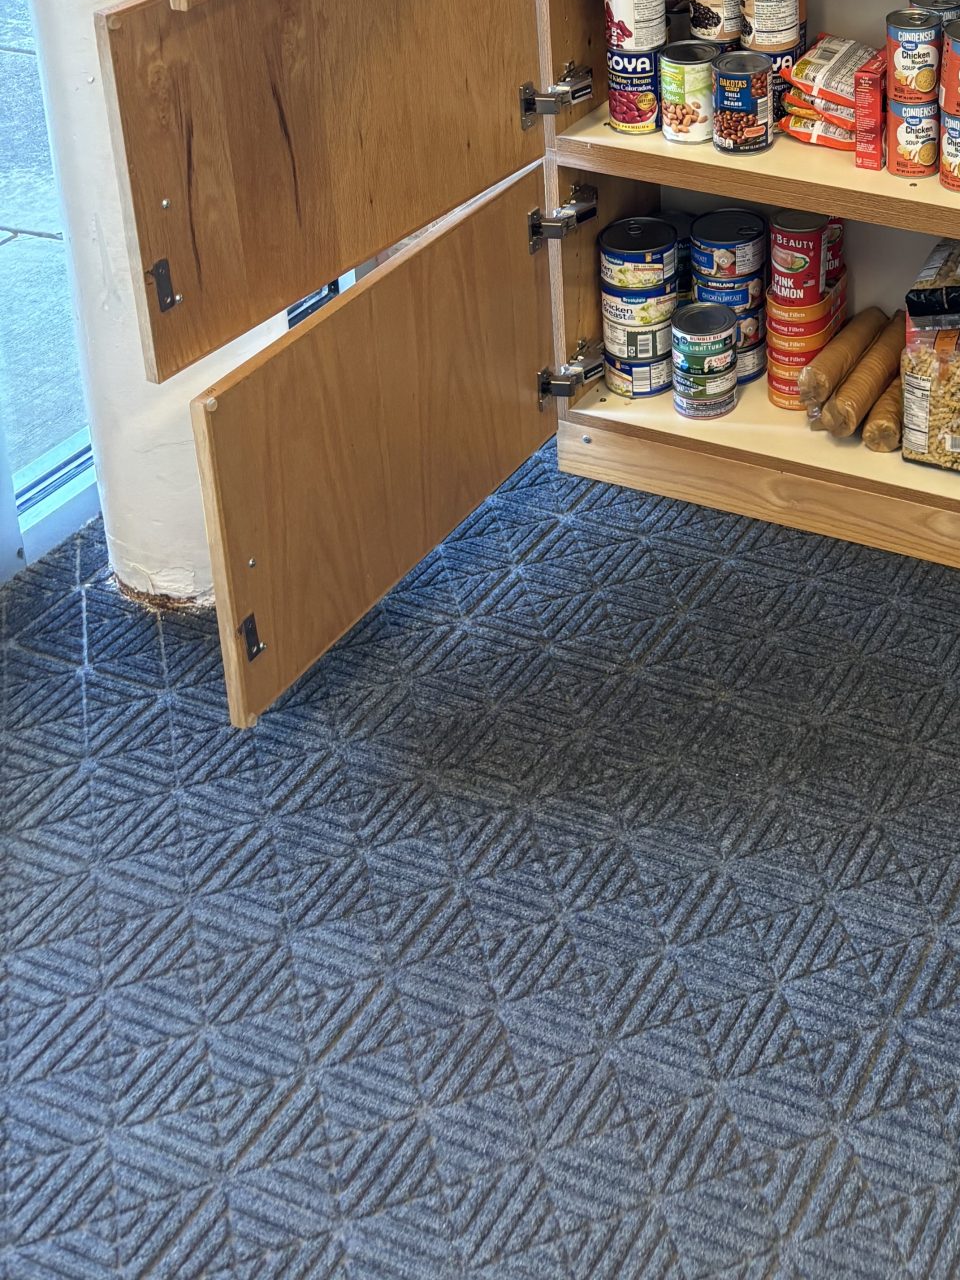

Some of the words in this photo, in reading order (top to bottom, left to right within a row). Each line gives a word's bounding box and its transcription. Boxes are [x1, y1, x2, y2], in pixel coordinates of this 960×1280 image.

[898, 30, 935, 41] CONDENSED
[902, 51, 930, 59] Chicken
[607, 52, 650, 72] GOYA
[720, 78, 747, 88] DAKOTA'S
[902, 106, 937, 117] CONDENSED
[905, 126, 933, 134] Chicken
[776, 233, 814, 250] BEAUTY
[774, 273, 794, 288] PINK
[603, 299, 633, 314] Chicken
